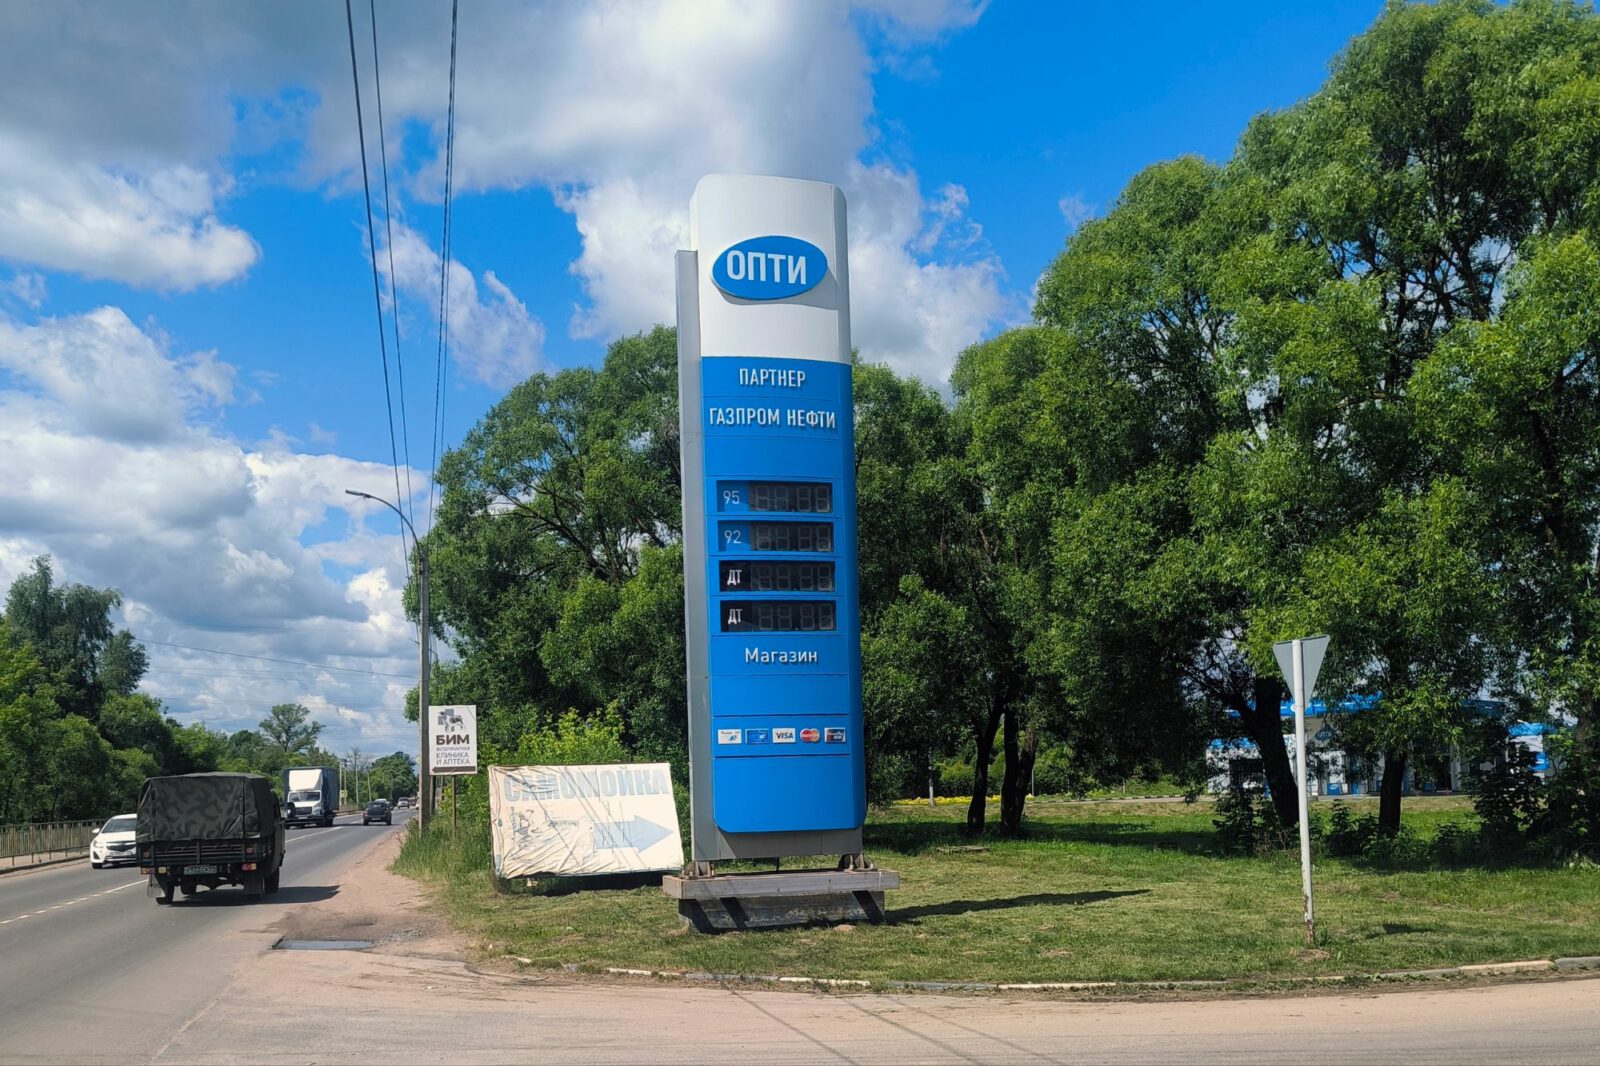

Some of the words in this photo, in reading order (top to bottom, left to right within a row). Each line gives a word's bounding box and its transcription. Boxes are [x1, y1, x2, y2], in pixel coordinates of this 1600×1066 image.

[726, 250, 807, 285] ОПТИ
[739, 368, 805, 387] ПАРТНЕР
[710, 407, 780, 426] ГАЗПРОМ
[787, 409, 835, 428] НЕФТИ
[723, 490, 740, 505] 95
[724, 530, 742, 545] 92
[727, 569, 742, 586] ДТ
[727, 608, 743, 625] ДТ
[745, 647, 818, 663] Магазин
[436, 733, 470, 746] БИМ
[775, 732, 794, 740] VISA
